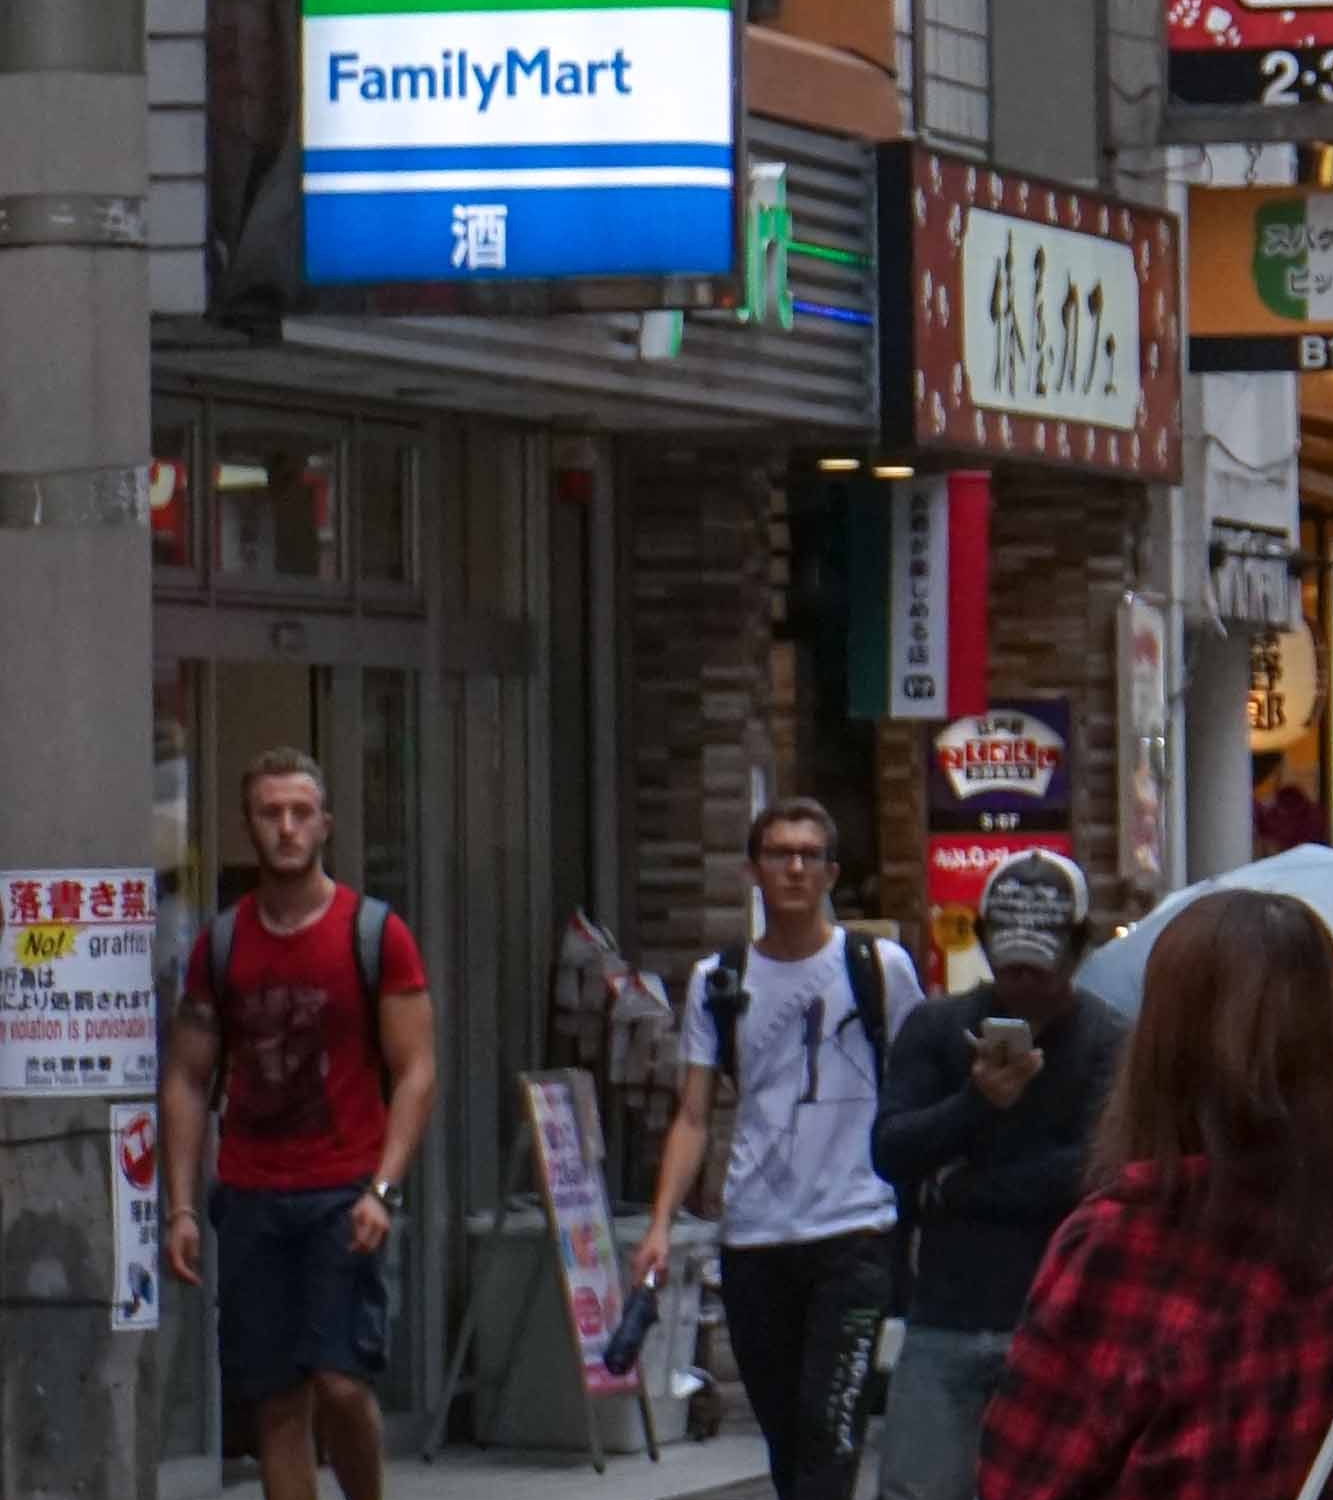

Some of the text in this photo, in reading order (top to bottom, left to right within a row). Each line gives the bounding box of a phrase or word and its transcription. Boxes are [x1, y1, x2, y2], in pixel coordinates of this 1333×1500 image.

[327, 47, 633, 114] FamilyMart
[449, 203, 508, 270] 酒
[988, 228, 1120, 400] 椿屋カフェ
[8, 879, 156, 921] 落書き禁
[24, 930, 66, 960] No!
